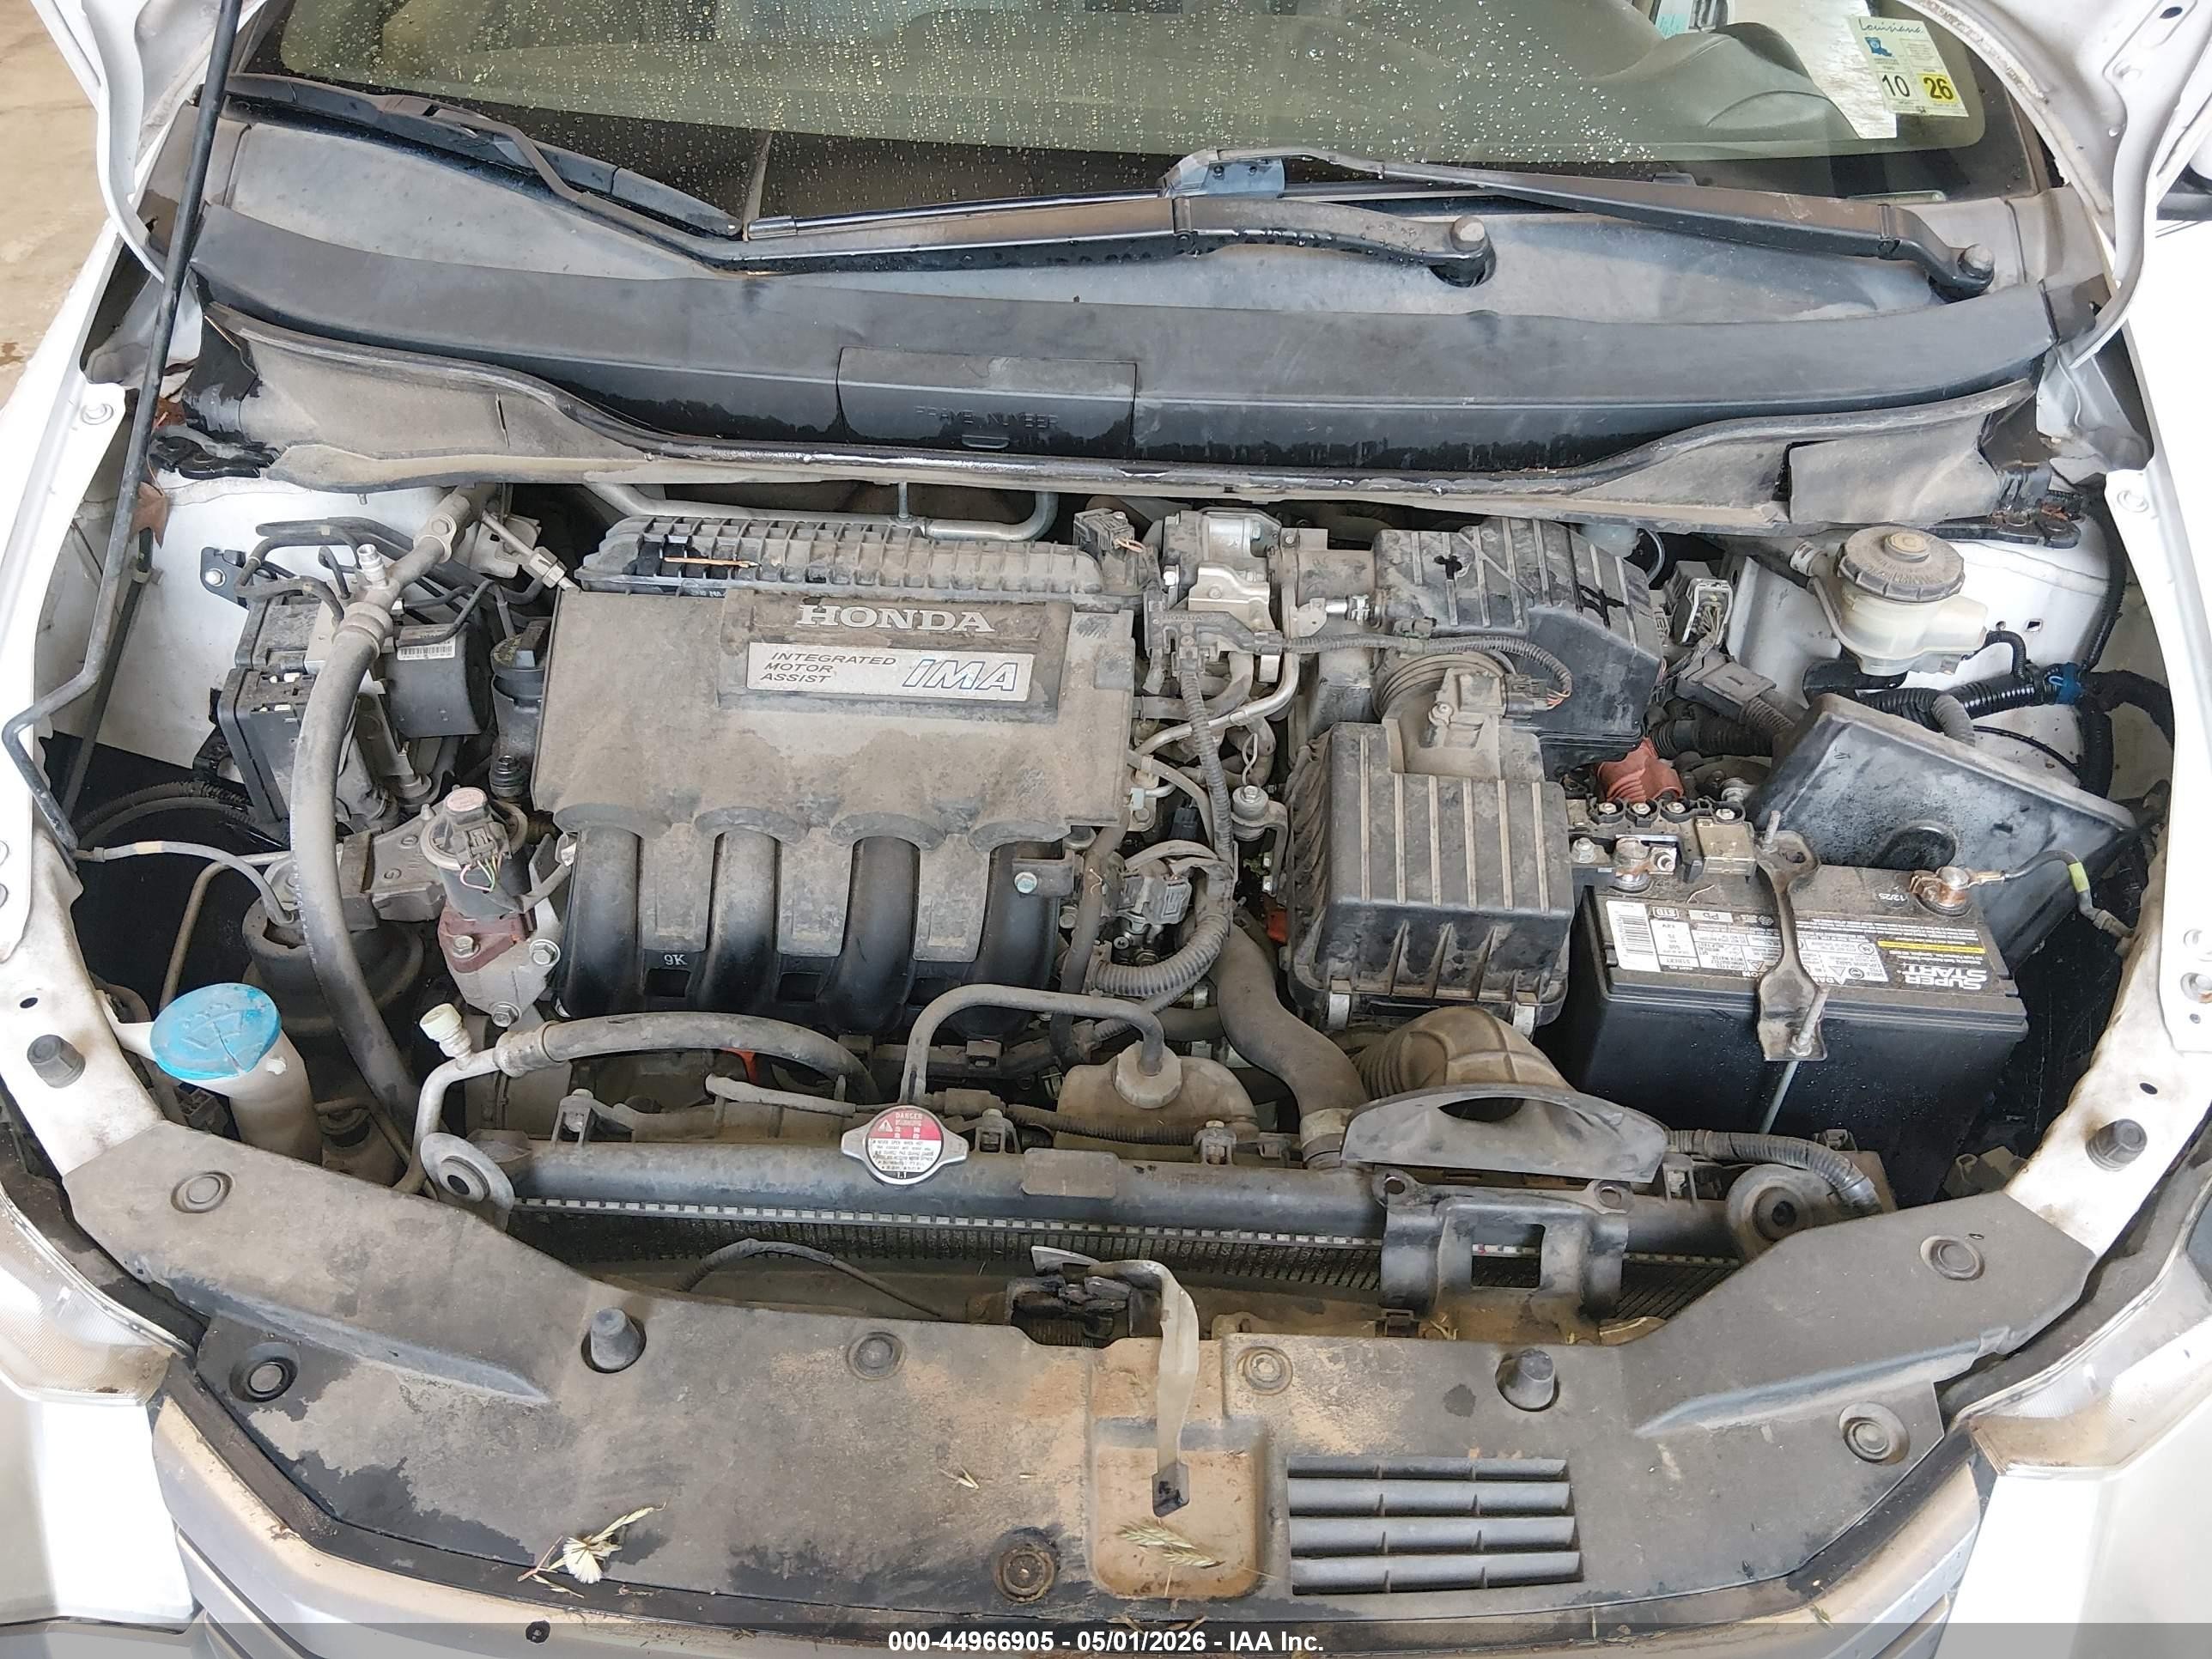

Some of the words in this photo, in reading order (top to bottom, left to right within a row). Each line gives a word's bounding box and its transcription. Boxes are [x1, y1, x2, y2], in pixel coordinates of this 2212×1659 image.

[1881, 74, 1911, 97] 10
[1923, 76, 1954, 100] 26
[914, 406, 974, 424] FRAME
[987, 411, 1059, 428] NUMBER
[796, 605, 995, 633] HONDA
[771, 652, 896, 666] INTEGRATED
[764, 662, 834, 673] MOTOR
[902, 659, 1018, 692] IMA
[760, 673, 831, 684] ASSIST
[1703, 912, 1719, 921] Pb
[664, 954, 688, 966] 9K
[1901, 963, 1988, 981] START
[1904, 975, 1982, 991] SUPER
